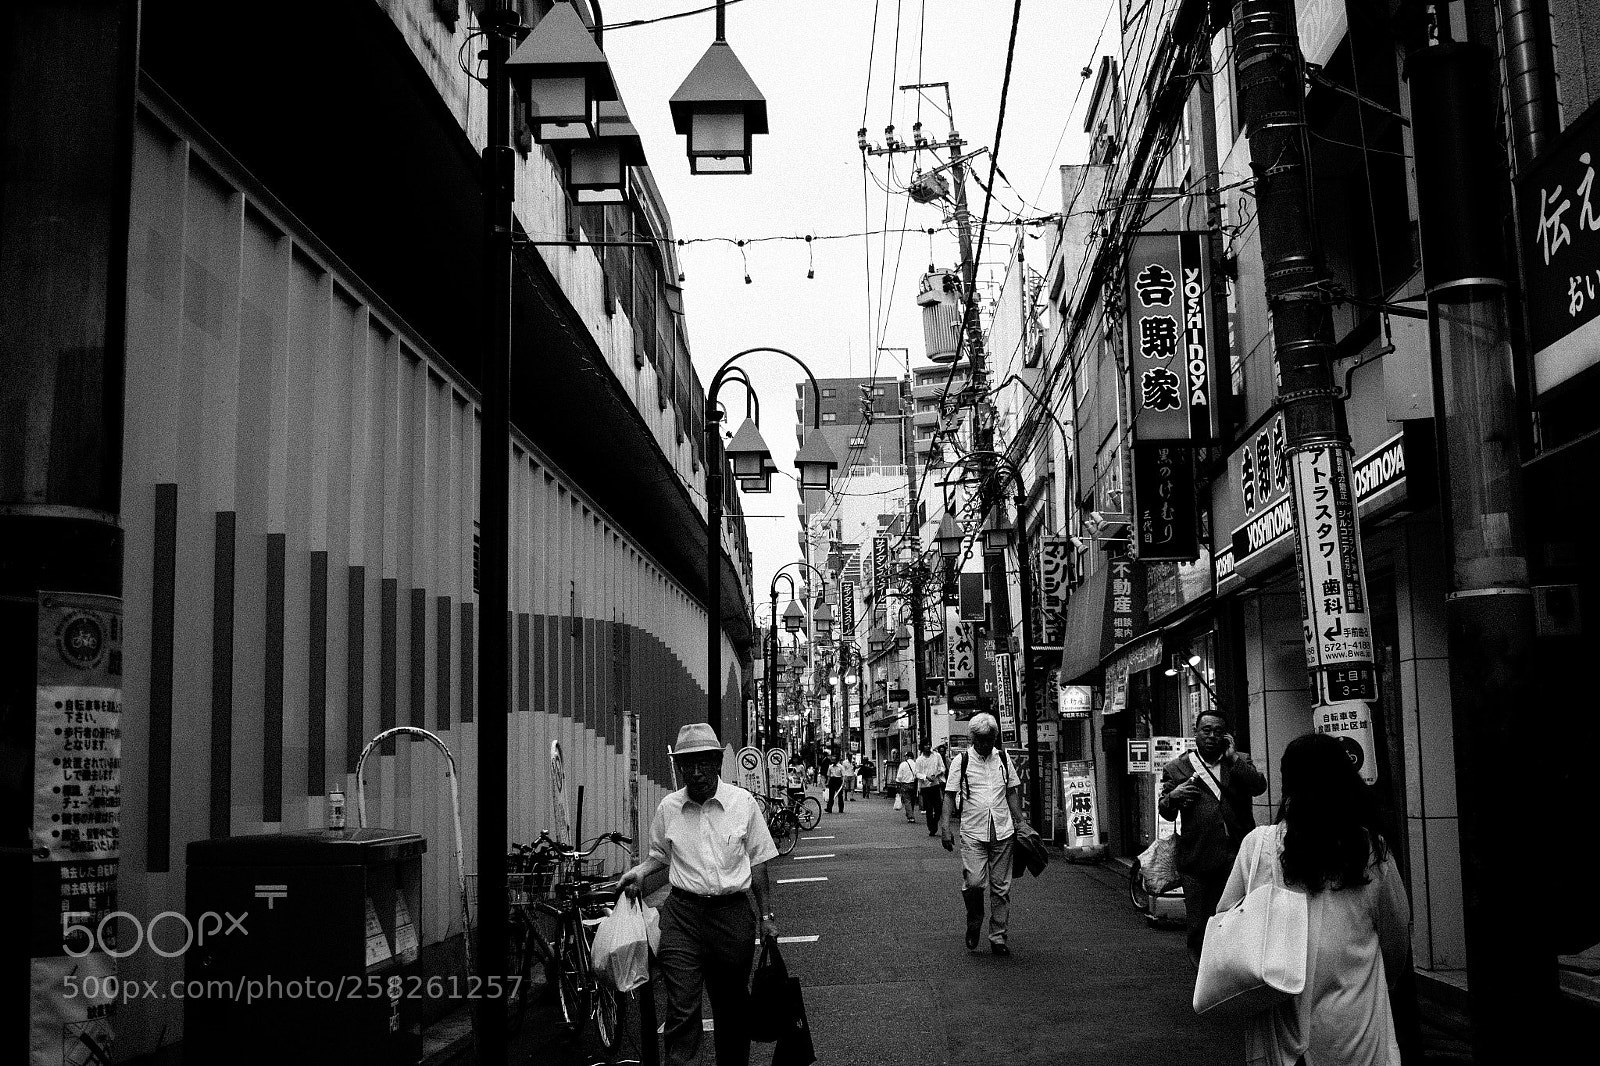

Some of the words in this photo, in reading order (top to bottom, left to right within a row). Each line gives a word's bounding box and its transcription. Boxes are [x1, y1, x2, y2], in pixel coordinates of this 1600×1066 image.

[1184, 268, 1207, 406] YOSHINOYA
[1247, 500, 1293, 552] YOSHINOYA
[1308, 450, 1342, 616] アトラスタワー歯科
[1112, 562, 1132, 613] 不動産
[1336, 670, 1369, 683] 上目黒
[1323, 711, 1357, 723] 自転車等
[1070, 781, 1091, 789] ABC
[1072, 793, 1094, 837] 麻雀
